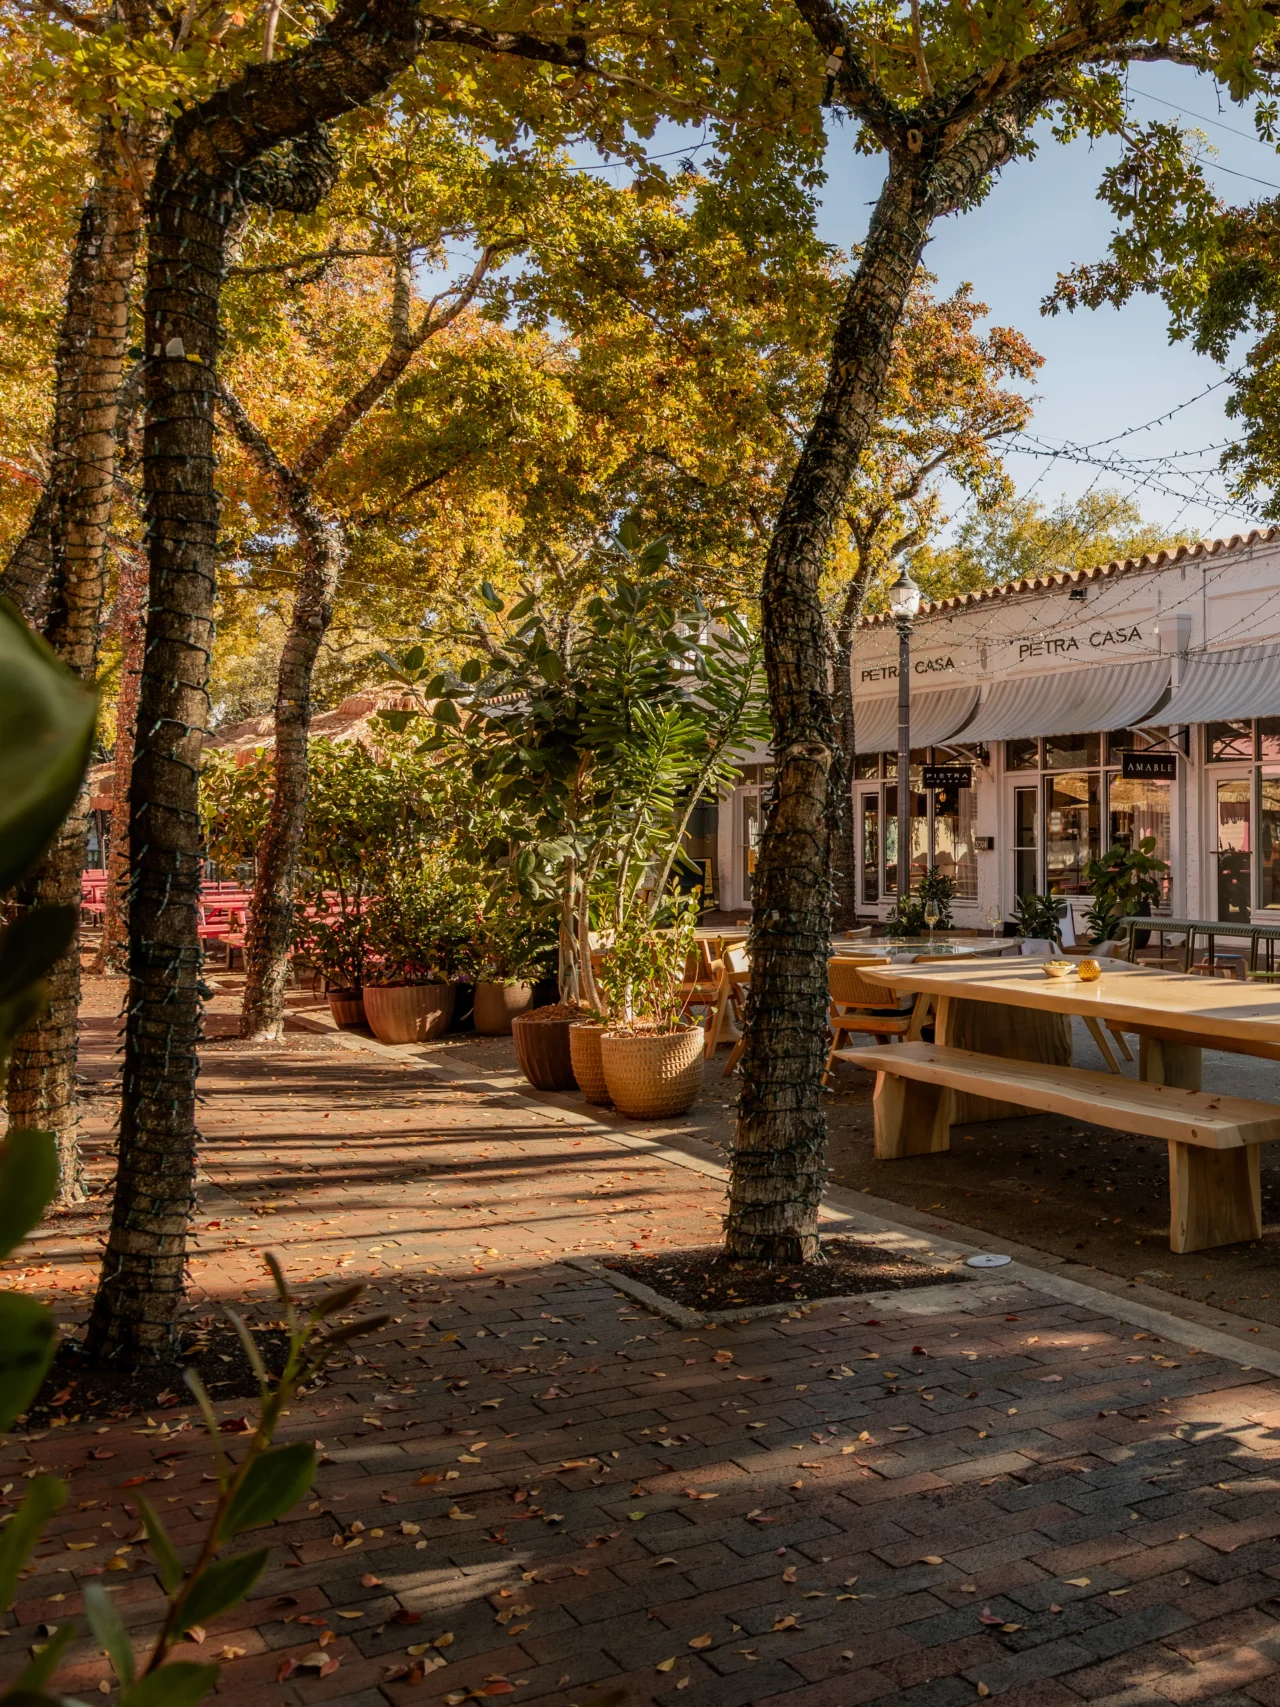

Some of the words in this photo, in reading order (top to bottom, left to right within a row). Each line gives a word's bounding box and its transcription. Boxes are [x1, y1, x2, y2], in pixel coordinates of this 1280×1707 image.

[1089, 626, 1143, 648] CASA
[914, 656, 956, 675] CASA
[1127, 763, 1173, 772] AMABLE
